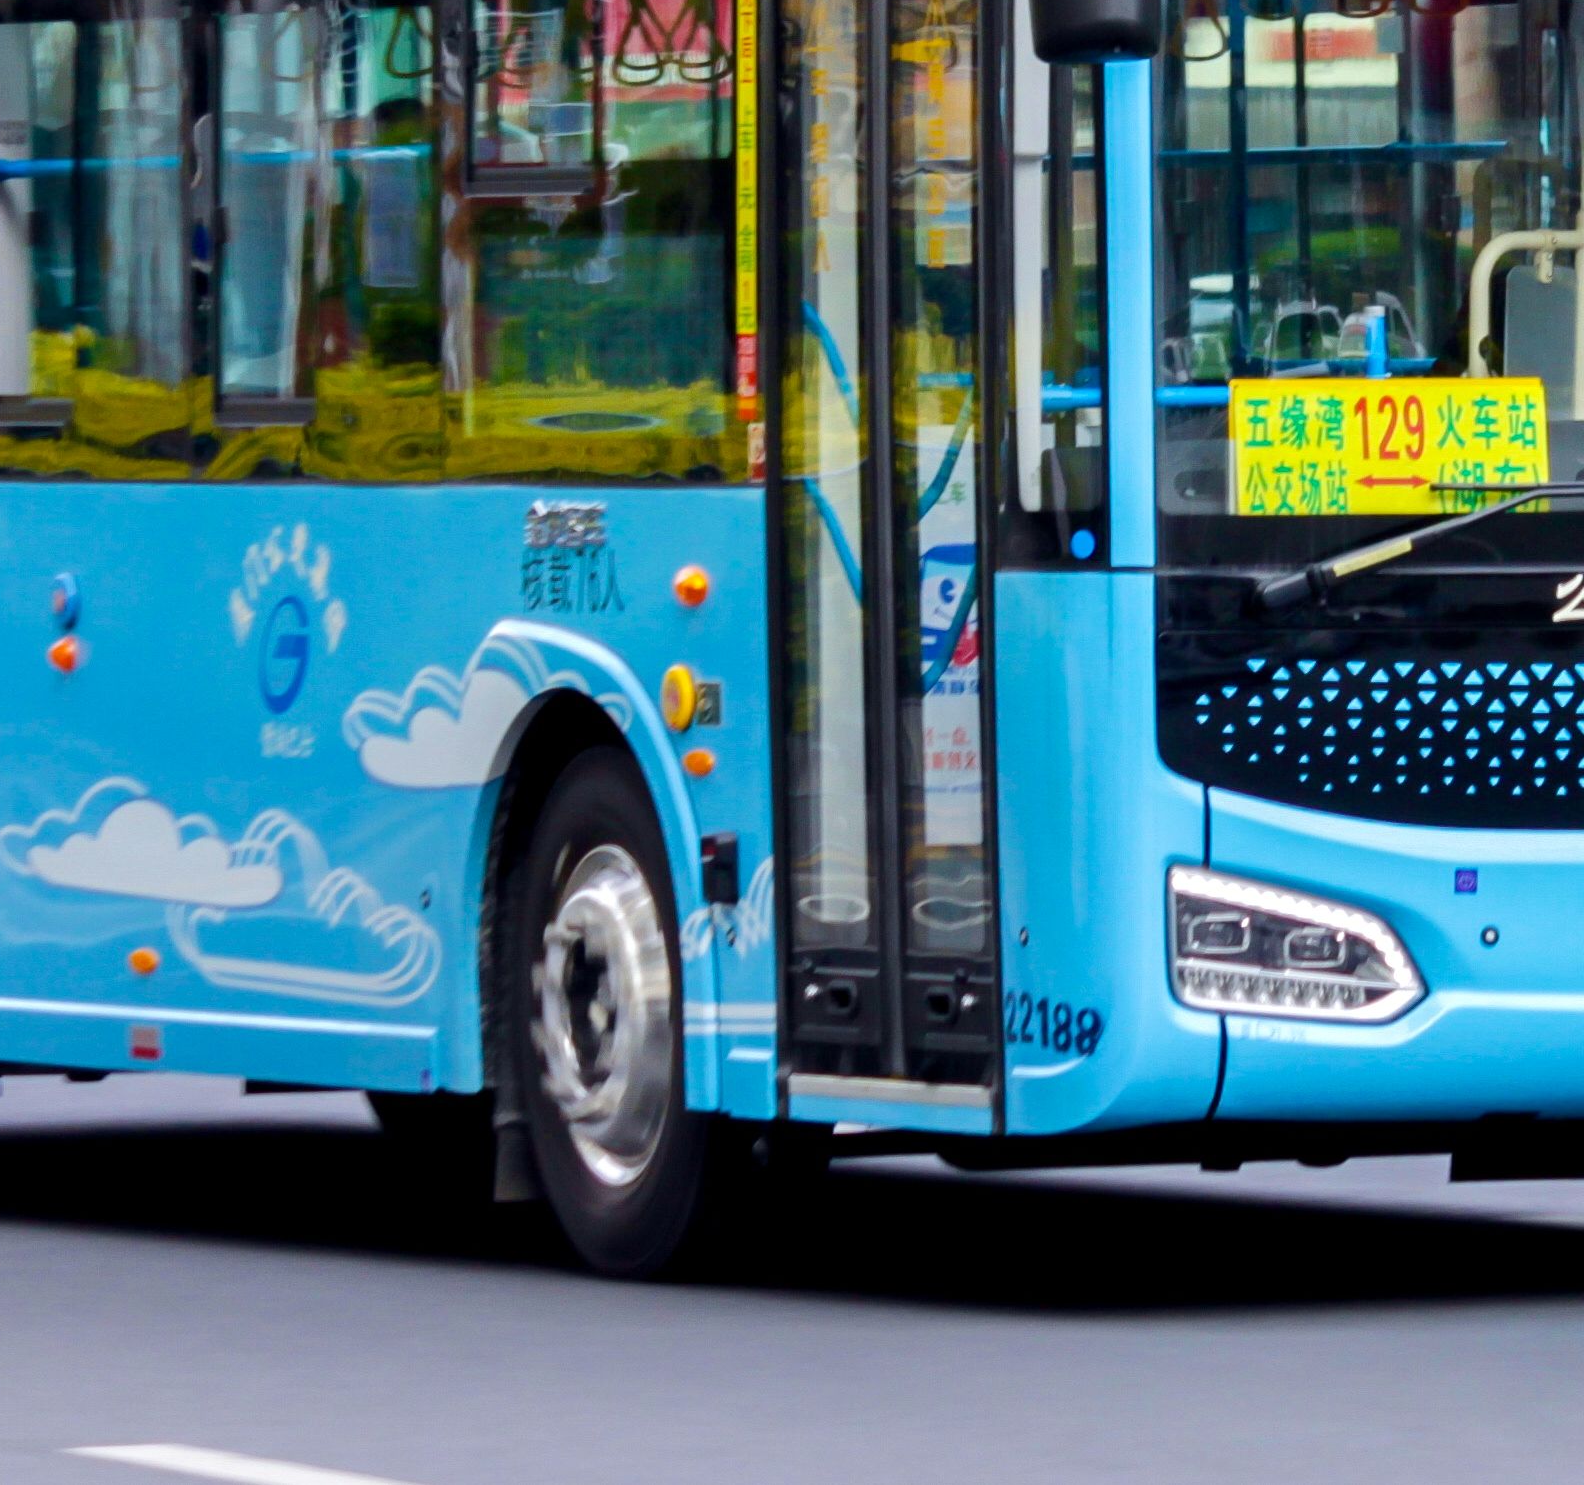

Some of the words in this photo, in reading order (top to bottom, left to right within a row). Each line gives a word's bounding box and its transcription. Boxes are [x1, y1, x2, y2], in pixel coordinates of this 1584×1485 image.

[1244, 394, 1346, 451] 五缘湾
[1353, 394, 1426, 461] 129
[1437, 394, 1538, 450] 火车站
[1245, 460, 1350, 514] 公交场站
[1005, 991, 1104, 1057] 22188
